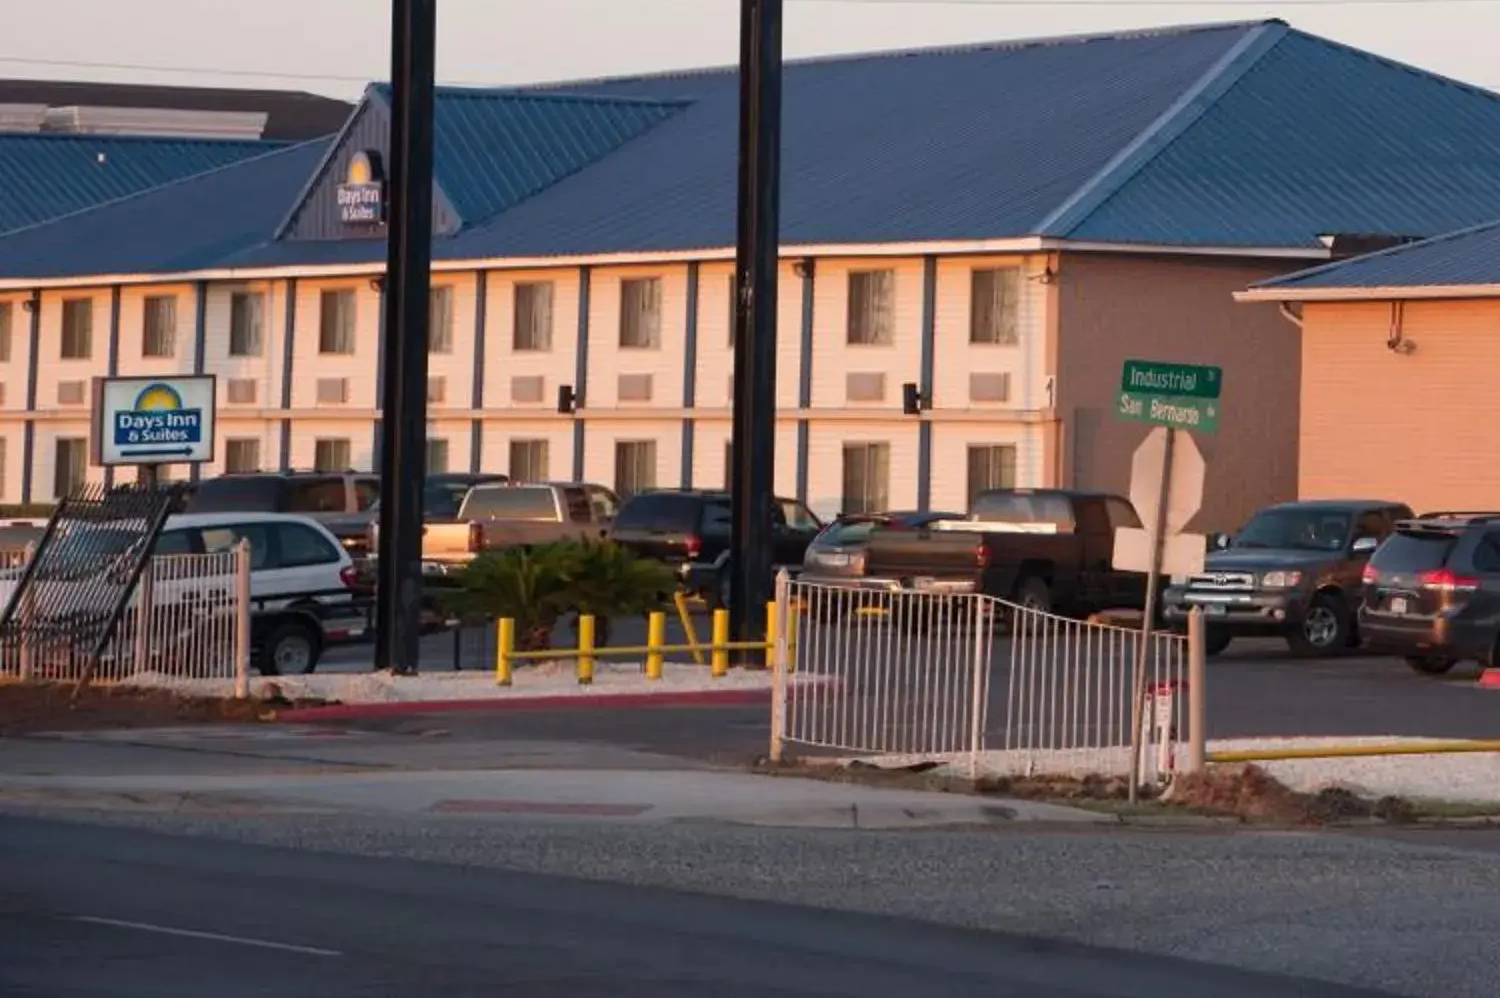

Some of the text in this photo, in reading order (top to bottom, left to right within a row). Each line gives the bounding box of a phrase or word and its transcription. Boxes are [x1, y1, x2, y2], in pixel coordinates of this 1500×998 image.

[1129, 366, 1197, 392] Industrial
[1119, 393, 1143, 415] San
[1150, 398, 1199, 425] Bernardo
[120, 413, 198, 430] Days Inn
[141, 427, 189, 442] Suites
